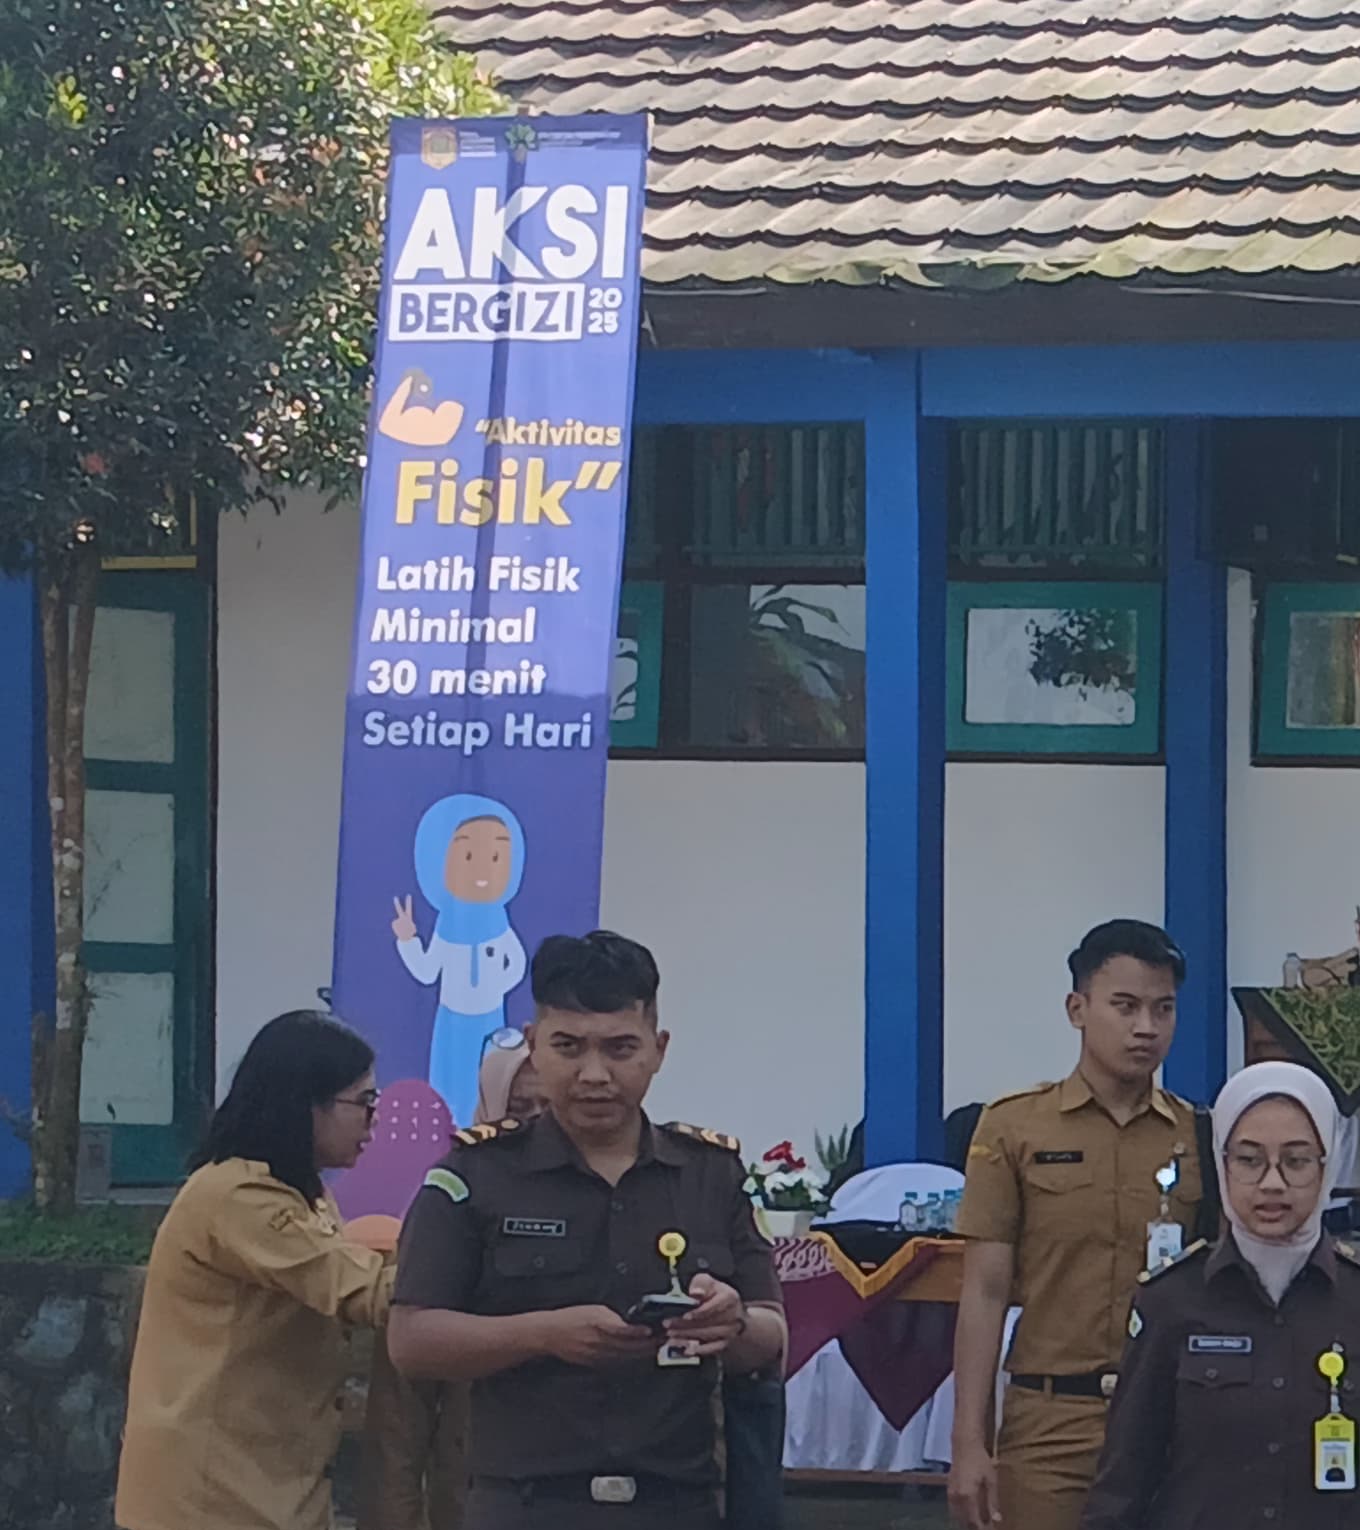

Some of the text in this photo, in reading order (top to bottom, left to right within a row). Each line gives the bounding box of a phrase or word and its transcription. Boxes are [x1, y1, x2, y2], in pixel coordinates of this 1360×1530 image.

[393, 184, 629, 281] AKSI
[396, 289, 576, 334] BERGIZI
[588, 287, 623, 309] 20
[588, 312, 619, 334] 25
[376, 555, 581, 592] Latih Fisik
[371, 607, 535, 645] Minimal
[366, 659, 547, 696] 30 menit
[362, 711, 592, 756] Setiap Hari
